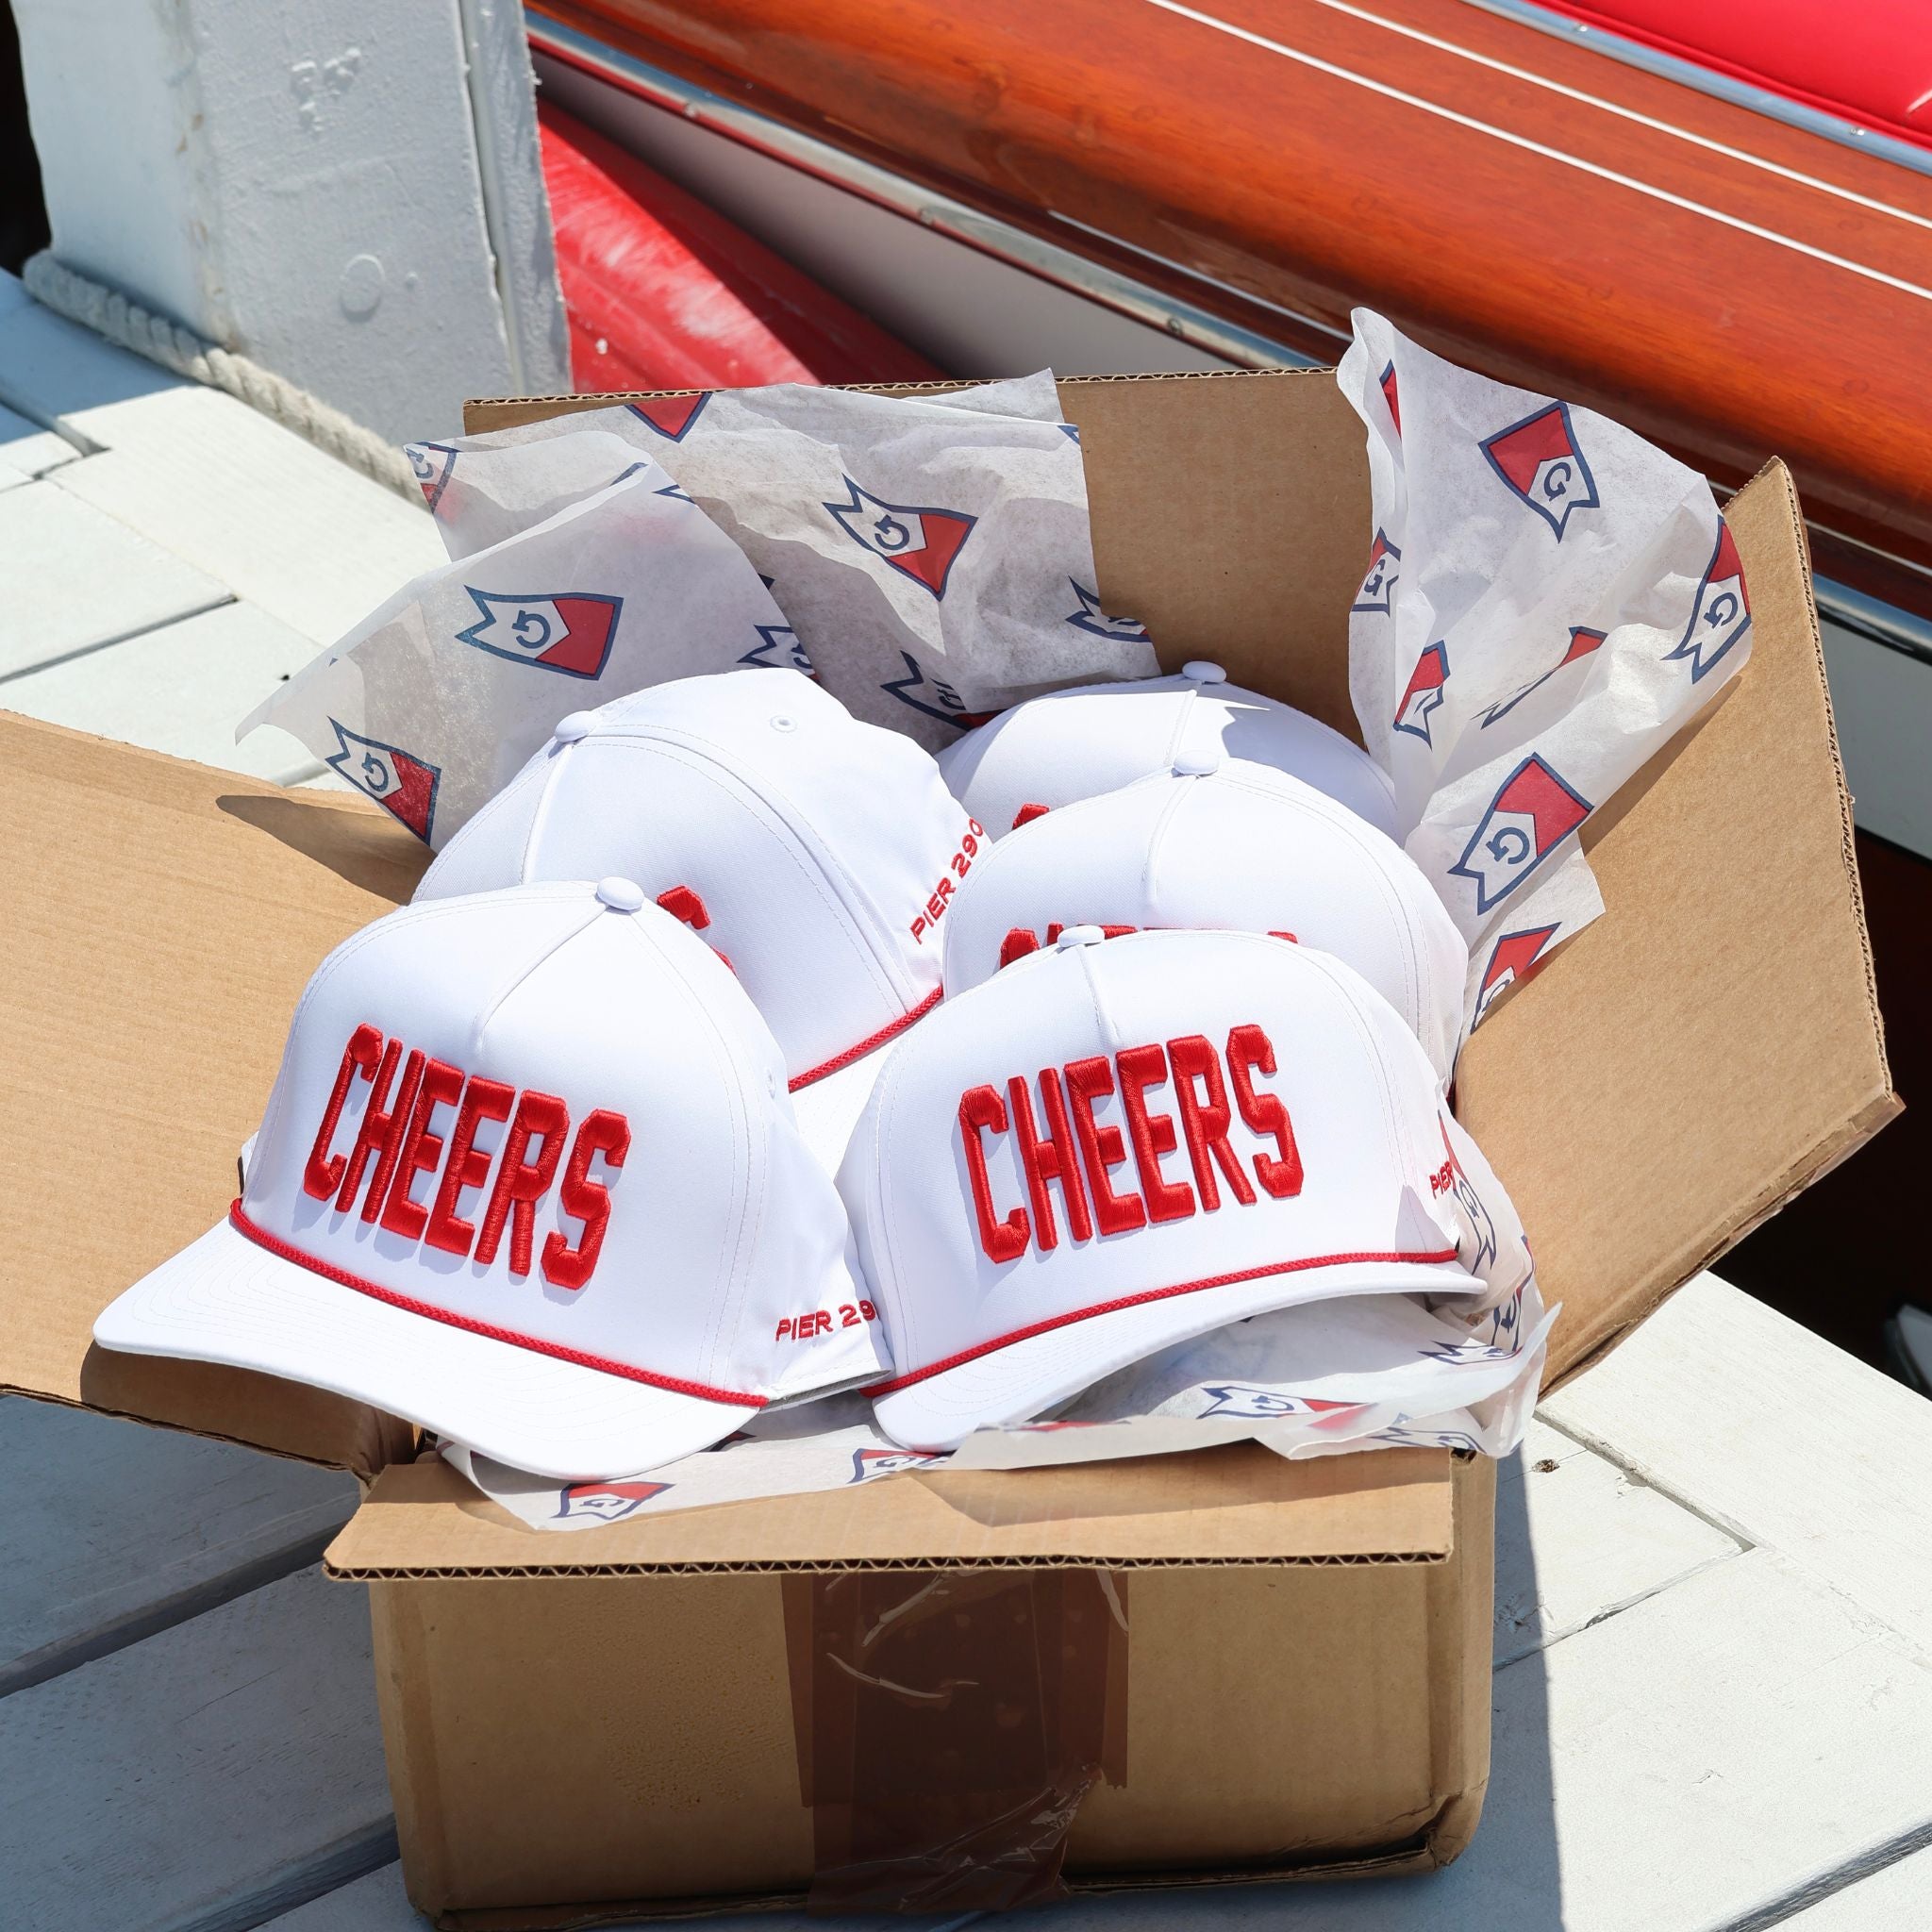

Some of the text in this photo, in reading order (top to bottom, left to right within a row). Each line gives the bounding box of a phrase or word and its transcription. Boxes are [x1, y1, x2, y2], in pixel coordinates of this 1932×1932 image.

[1543, 461, 1572, 501] G
[874, 514, 910, 551] G
[511, 609, 551, 649] G
[1703, 592, 1739, 629] G
[361, 752, 390, 792] G
[1485, 826, 1530, 865] G
[909, 817, 983, 944] PIER 290
[303, 1023, 631, 1291] CHEERS
[958, 1024, 1304, 1264] CHEERS
[776, 1310, 833, 1341] PIER
